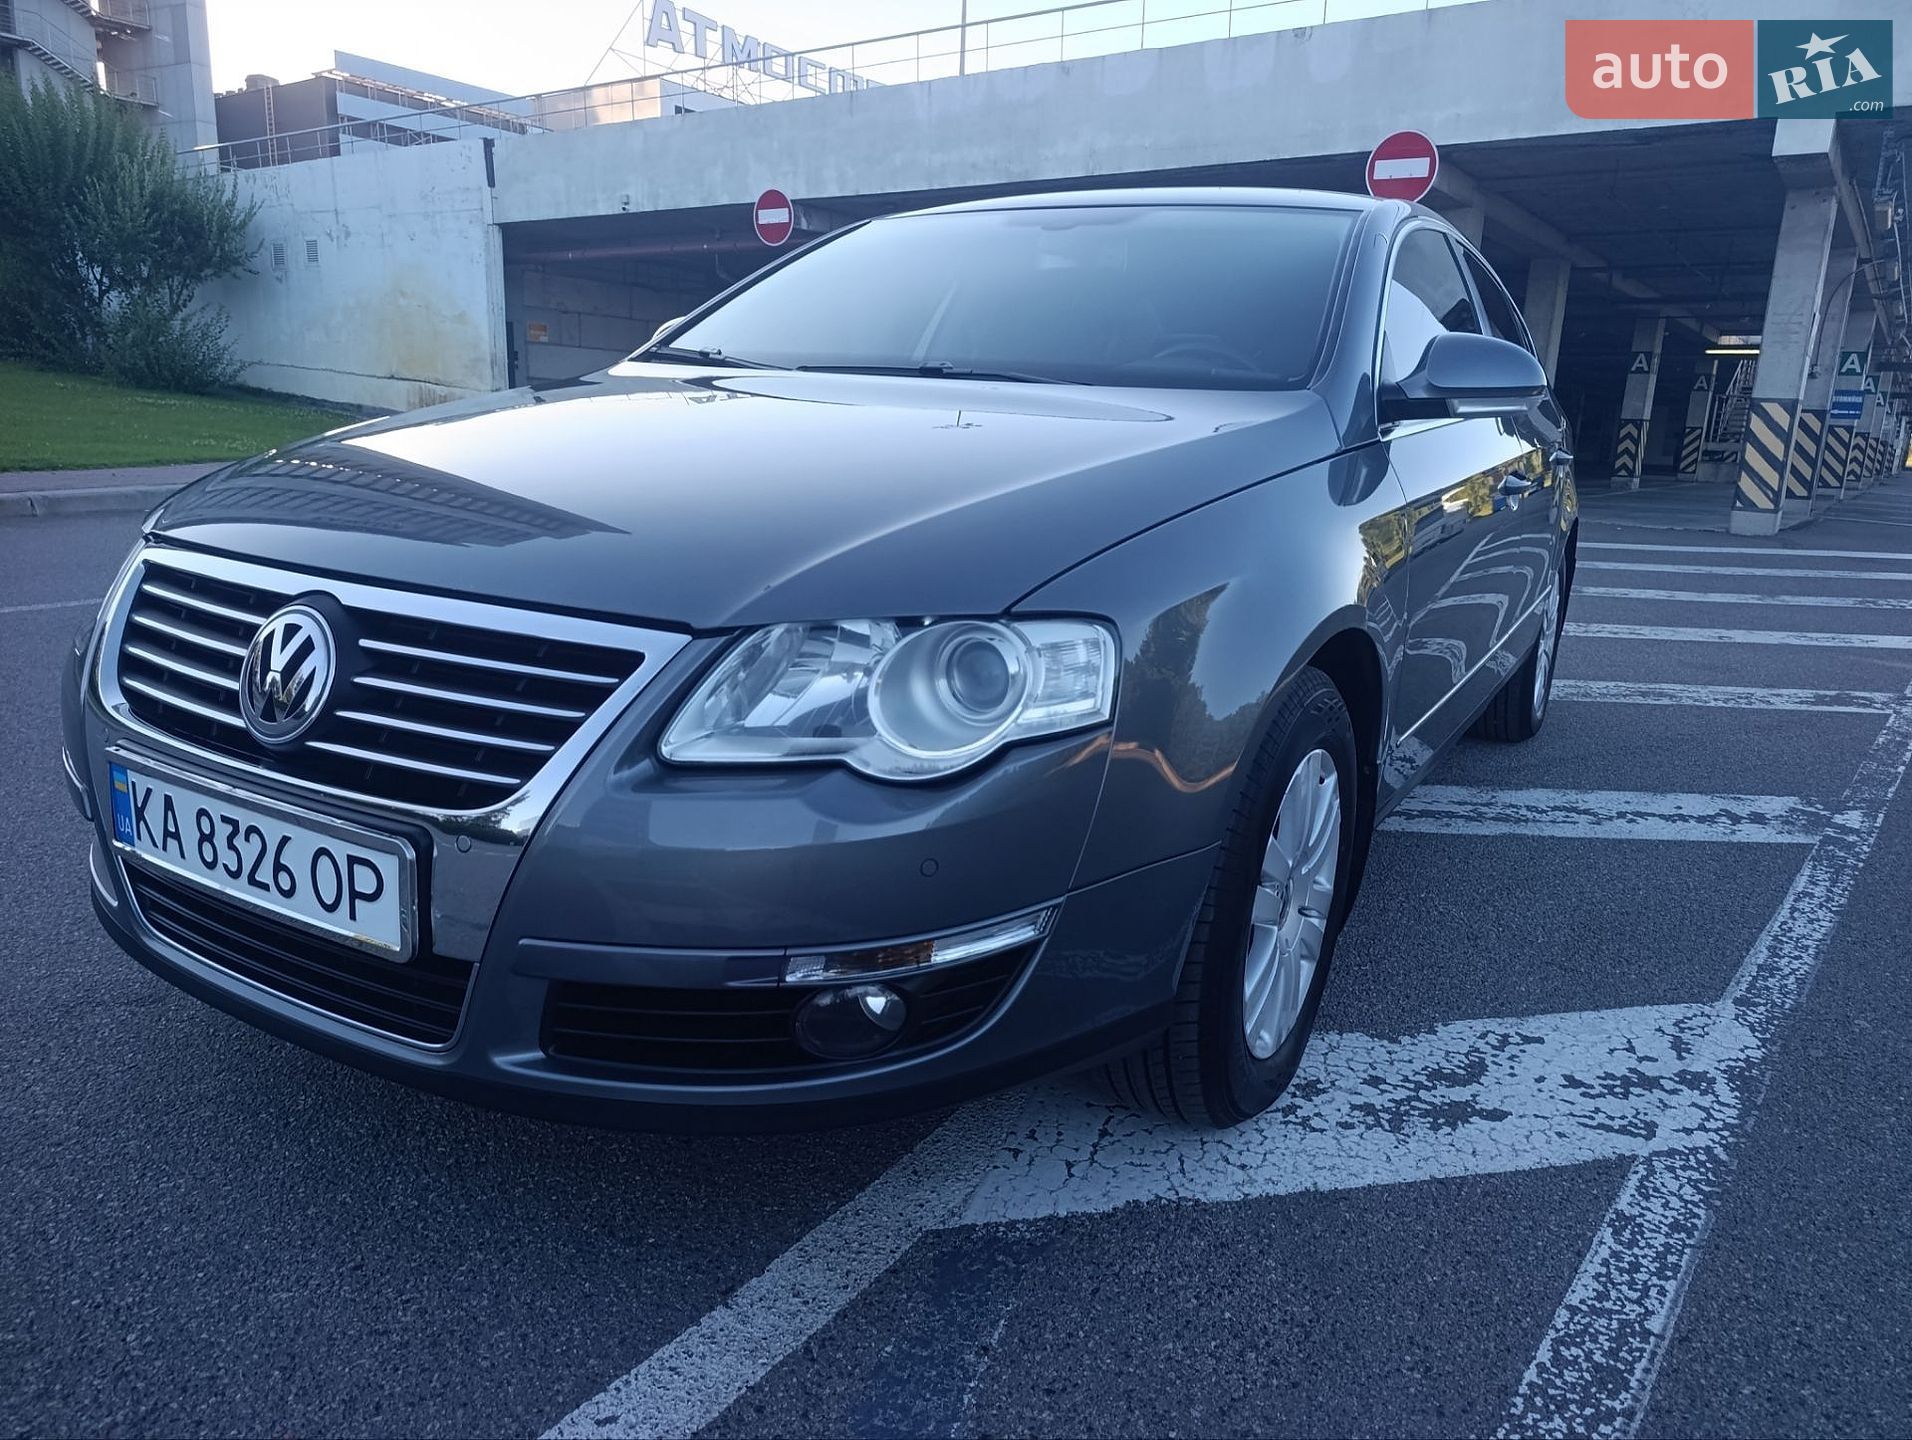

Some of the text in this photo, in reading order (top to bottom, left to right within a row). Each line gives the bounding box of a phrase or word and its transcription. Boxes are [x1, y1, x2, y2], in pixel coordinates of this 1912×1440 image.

[1631, 352, 1649, 372] A
[1841, 353, 1861, 373] A
[1693, 375, 1708, 390] A
[117, 814, 132, 837] UA
[131, 779, 385, 922] KA 8326 OP
